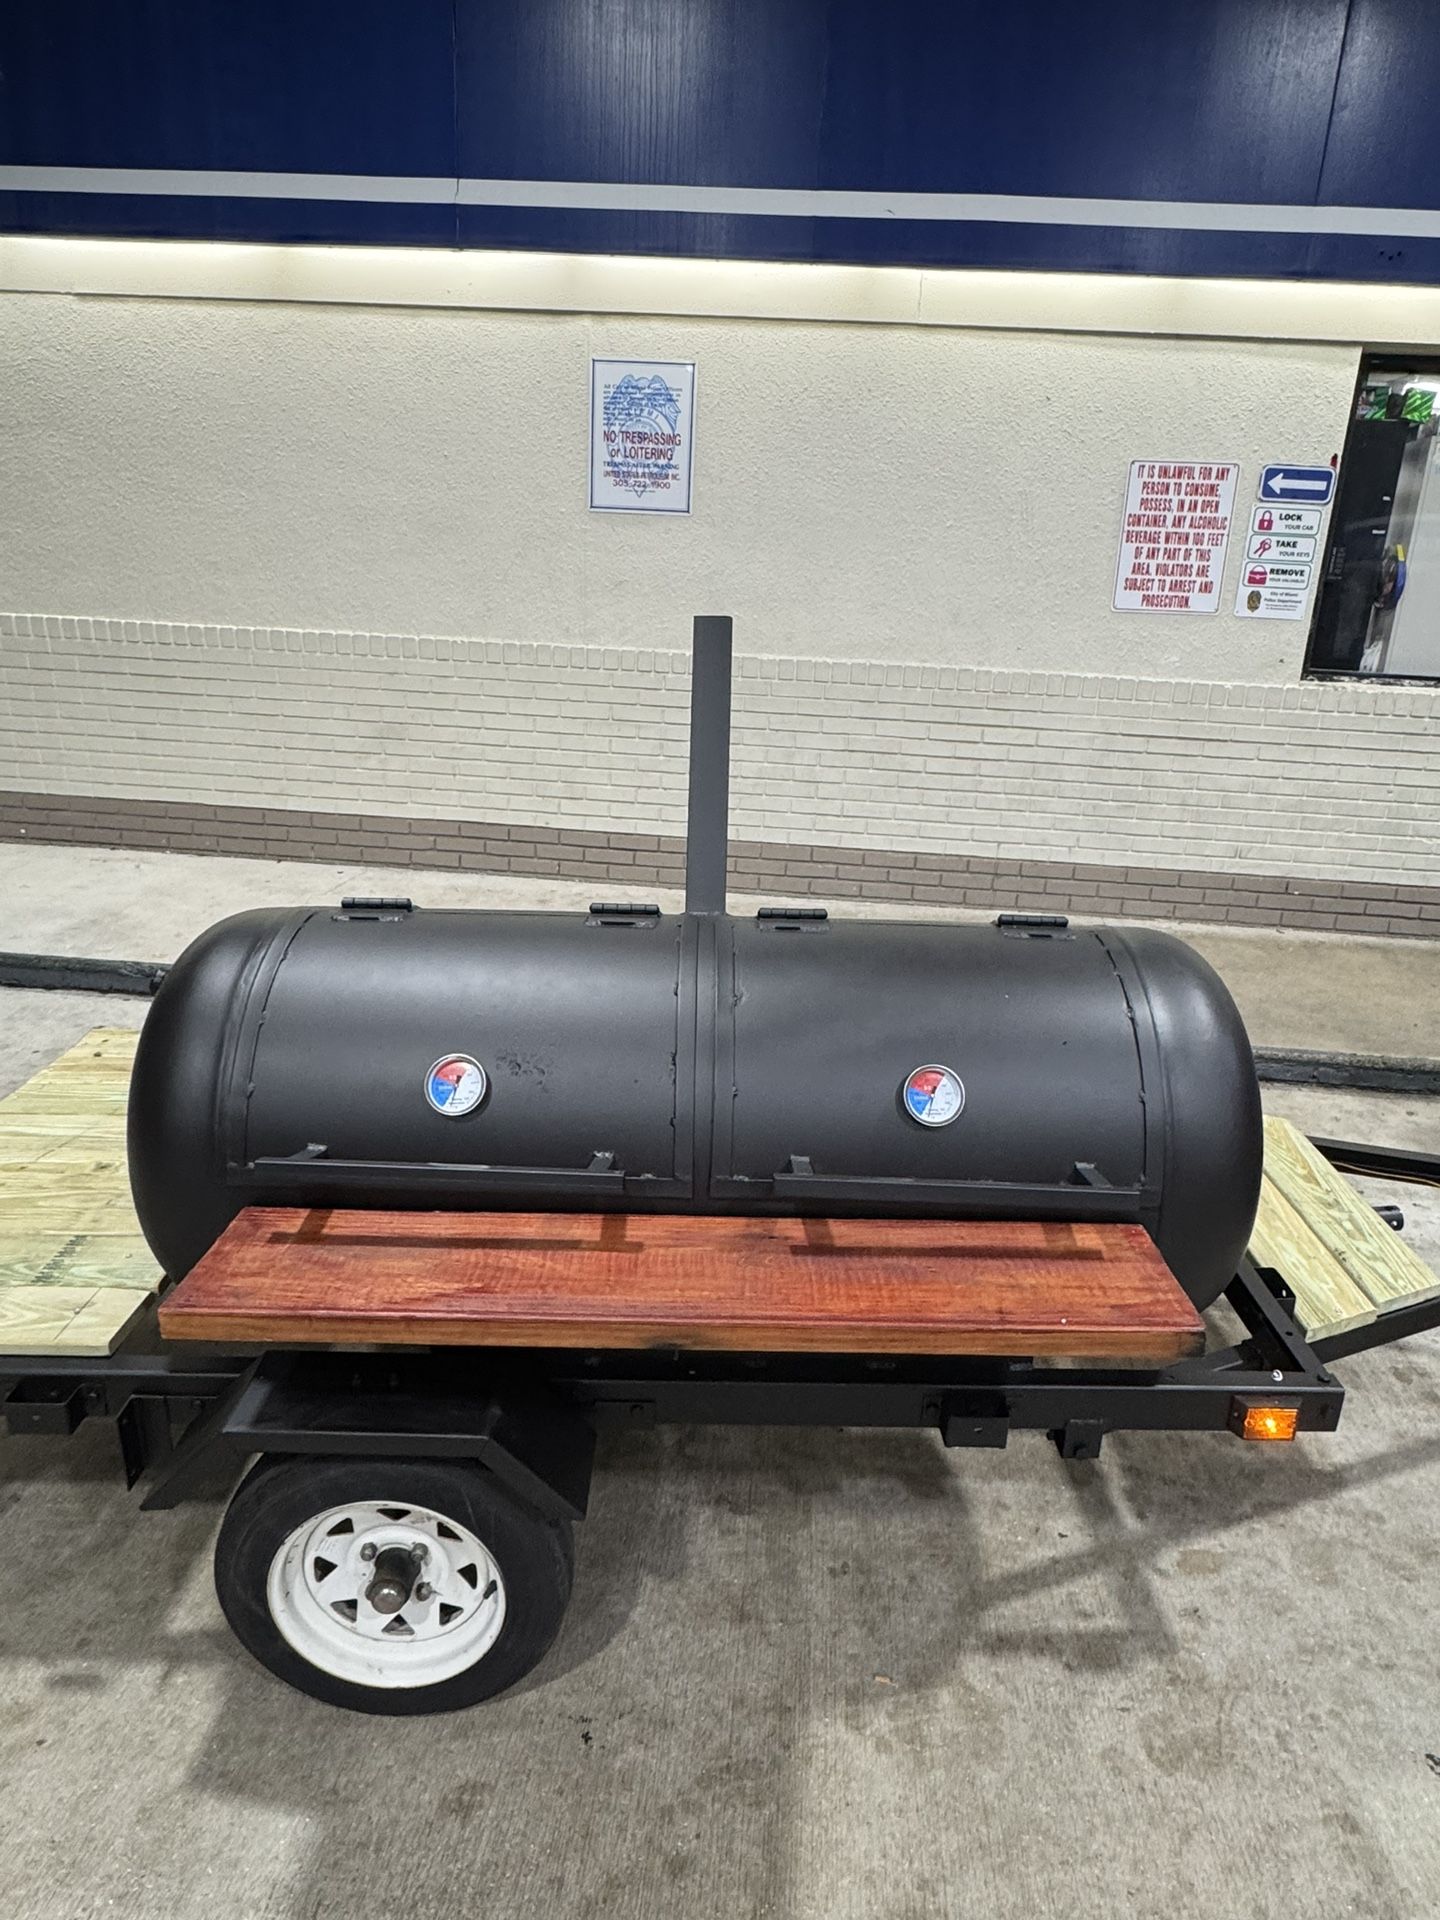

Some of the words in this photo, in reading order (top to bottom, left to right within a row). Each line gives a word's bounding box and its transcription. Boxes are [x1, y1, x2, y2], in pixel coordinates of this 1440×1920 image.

[603, 431, 616, 443] NO
[619, 431, 681, 446] TRESPASSING
[610, 448, 620, 457] or
[624, 446, 673, 461] LOITERING
[603, 470, 620, 478] UNITED
[1138, 465, 1145, 479] IT
[1148, 465, 1156, 478] IS
[1158, 465, 1196, 479] UNLAWFUL
[1198, 467, 1212, 480] FOR
[1215, 467, 1230, 481] ANY
[1141, 482, 1170, 495] PERSON
[1173, 483, 1182, 496] TO
[1139, 498, 1174, 513] POSSESS,
[1177, 499, 1185, 512] IN
[1187, 499, 1197, 512] AN
[1201, 499, 1219, 513] OPEN
[1127, 514, 1168, 529] CONTAINER,
[1171, 515, 1186, 528] ANY
[1188, 516, 1227, 530] ALCOHOLIC
[1279, 513, 1302, 521] LOCK
[1125, 531, 1161, 544] BEVERAGE
[1164, 532, 1190, 545] WITHIN
[1192, 532, 1204, 546] 100
[1207, 533, 1224, 546] FEET
[1276, 540, 1298, 548] TAKE
[1134, 546, 1143, 560] OF
[1145, 547, 1161, 560] ANY
[1163, 547, 1181, 561] PART
[1183, 548, 1193, 561] OF
[1196, 549, 1211, 562] THIS
[1155, 563, 1193, 577] VIOLATORS
[1196, 564, 1210, 577] ARE
[1269, 568, 1305, 576] REMOVE
[1124, 578, 1155, 591] SUBJECT
[1158, 579, 1166, 592] TO
[1168, 579, 1196, 592] ARREST
[1198, 580, 1214, 593] AND
